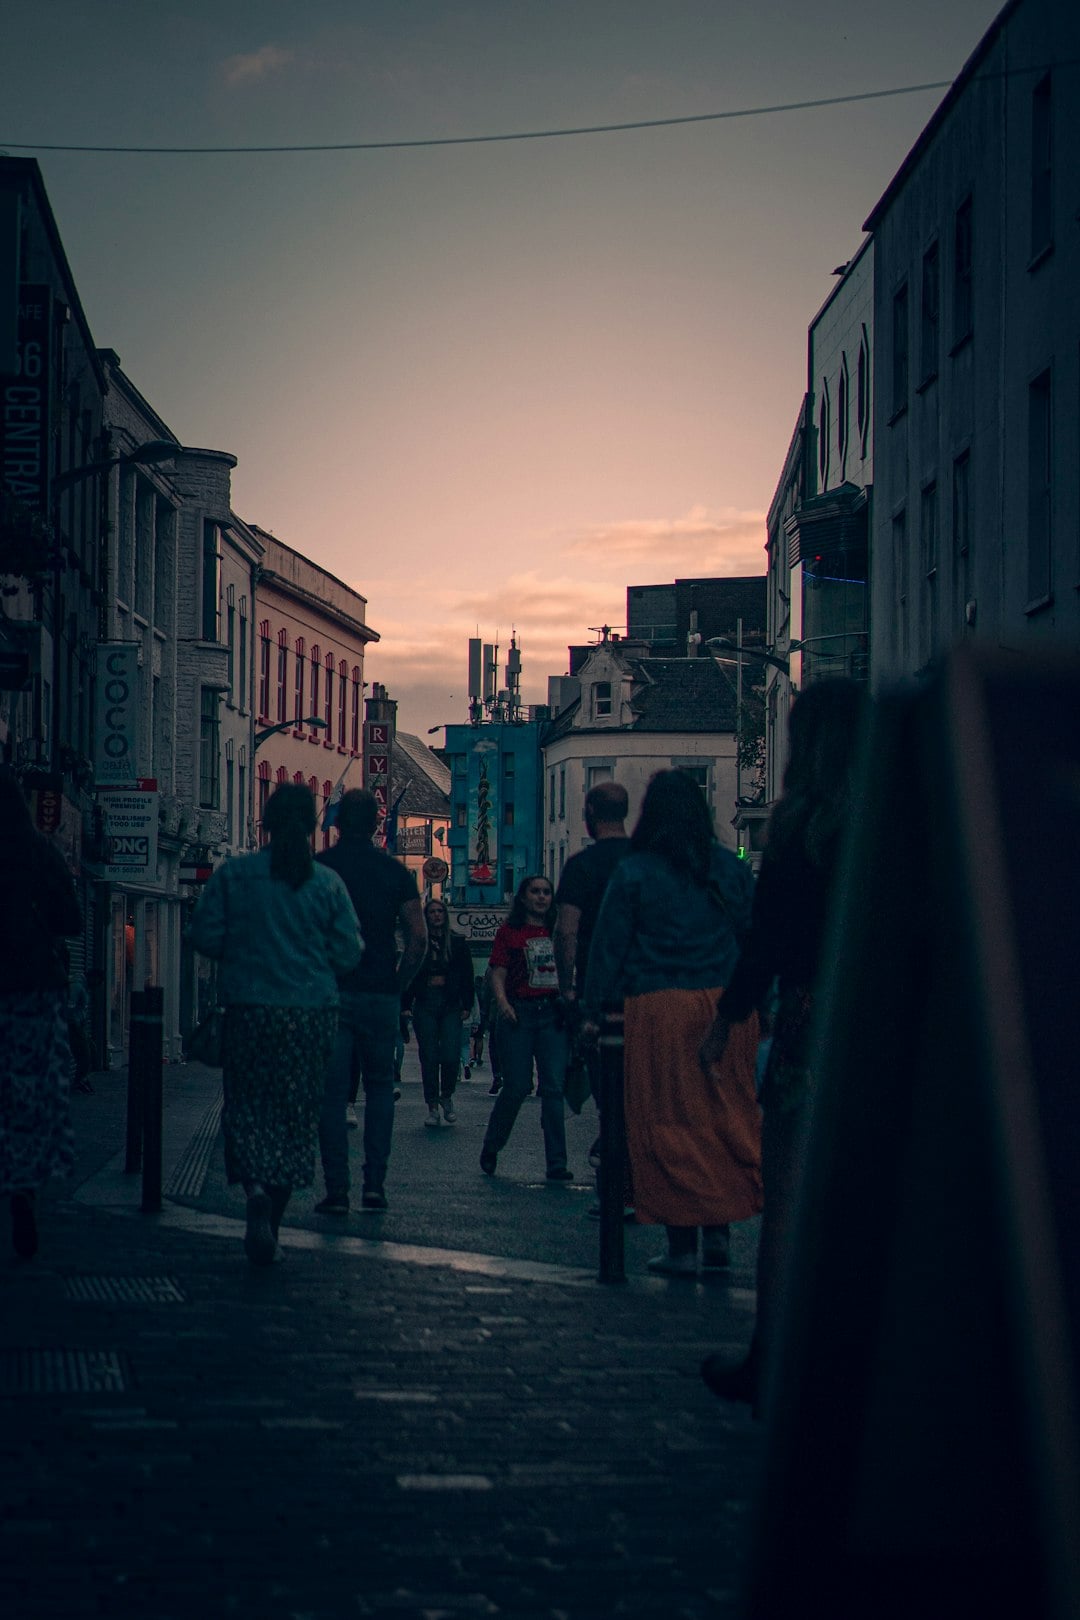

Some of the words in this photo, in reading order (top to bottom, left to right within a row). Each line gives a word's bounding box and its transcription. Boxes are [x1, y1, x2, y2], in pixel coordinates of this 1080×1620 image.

[16, 303, 42, 320] AFE
[4, 386, 41, 499] CENTRA
[103, 652, 130, 758] COCO
[396, 826, 426, 837] ARTER
[456, 912, 504, 928] Cladda
[466, 928, 498, 939] Jewel
